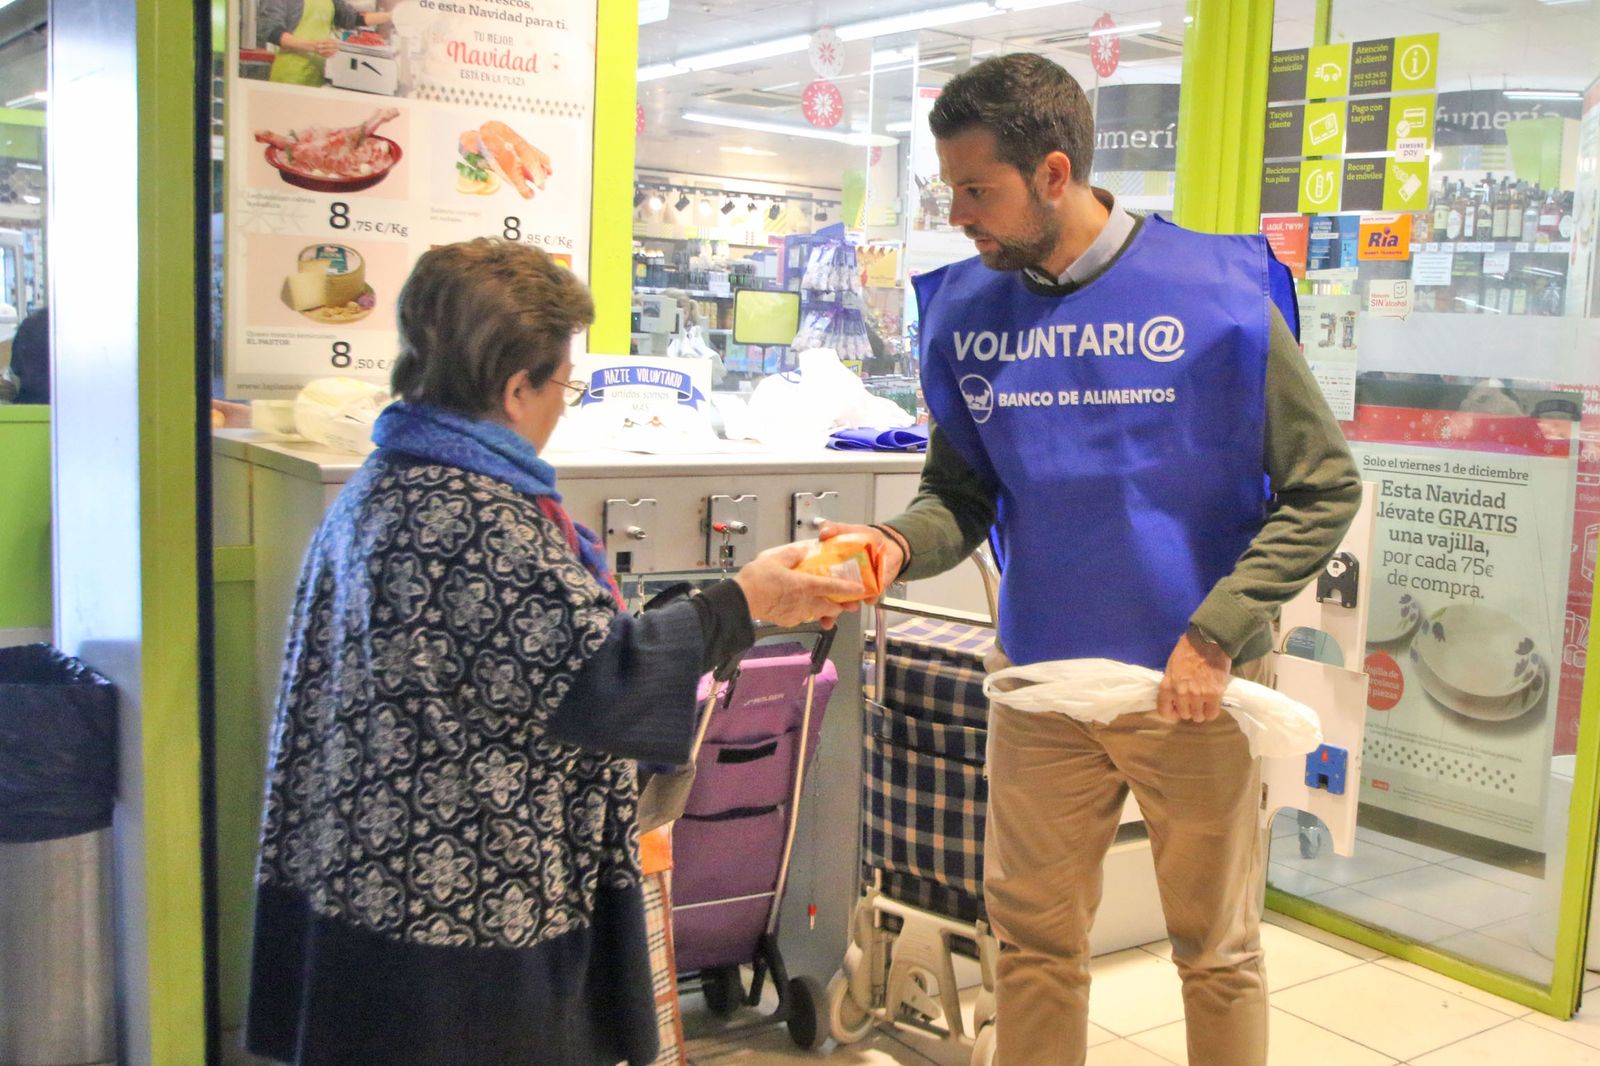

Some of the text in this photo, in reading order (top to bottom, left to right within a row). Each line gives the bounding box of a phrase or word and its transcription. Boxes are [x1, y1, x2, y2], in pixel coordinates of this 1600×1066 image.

[420, 0, 435, 9] de
[438, 2, 465, 14] esta
[469, 5, 522, 23] Navidad
[525, 17, 554, 28] para
[447, 40, 539, 73] Navidad
[1269, 111, 1293, 121] Tarjeta
[1351, 115, 1375, 124] tarjeta
[1368, 226, 1399, 247] Ria
[952, 315, 1185, 362] VOLUNTARI@
[604, 368, 683, 388] HAZTE VOLUNTARIO
[998, 388, 1176, 407] BANCO DE ALIMENTOS
[1363, 455, 1529, 481] Solo el viernes 1 de diciembre
[1381, 479, 1506, 509] Esta Navidad
[1438, 508, 1518, 534] GRATIS
[1389, 528, 1490, 557] una vajilla,
[1382, 550, 1412, 567] por
[1415, 553, 1457, 573] cada
[1387, 569, 1484, 600] de compra.
